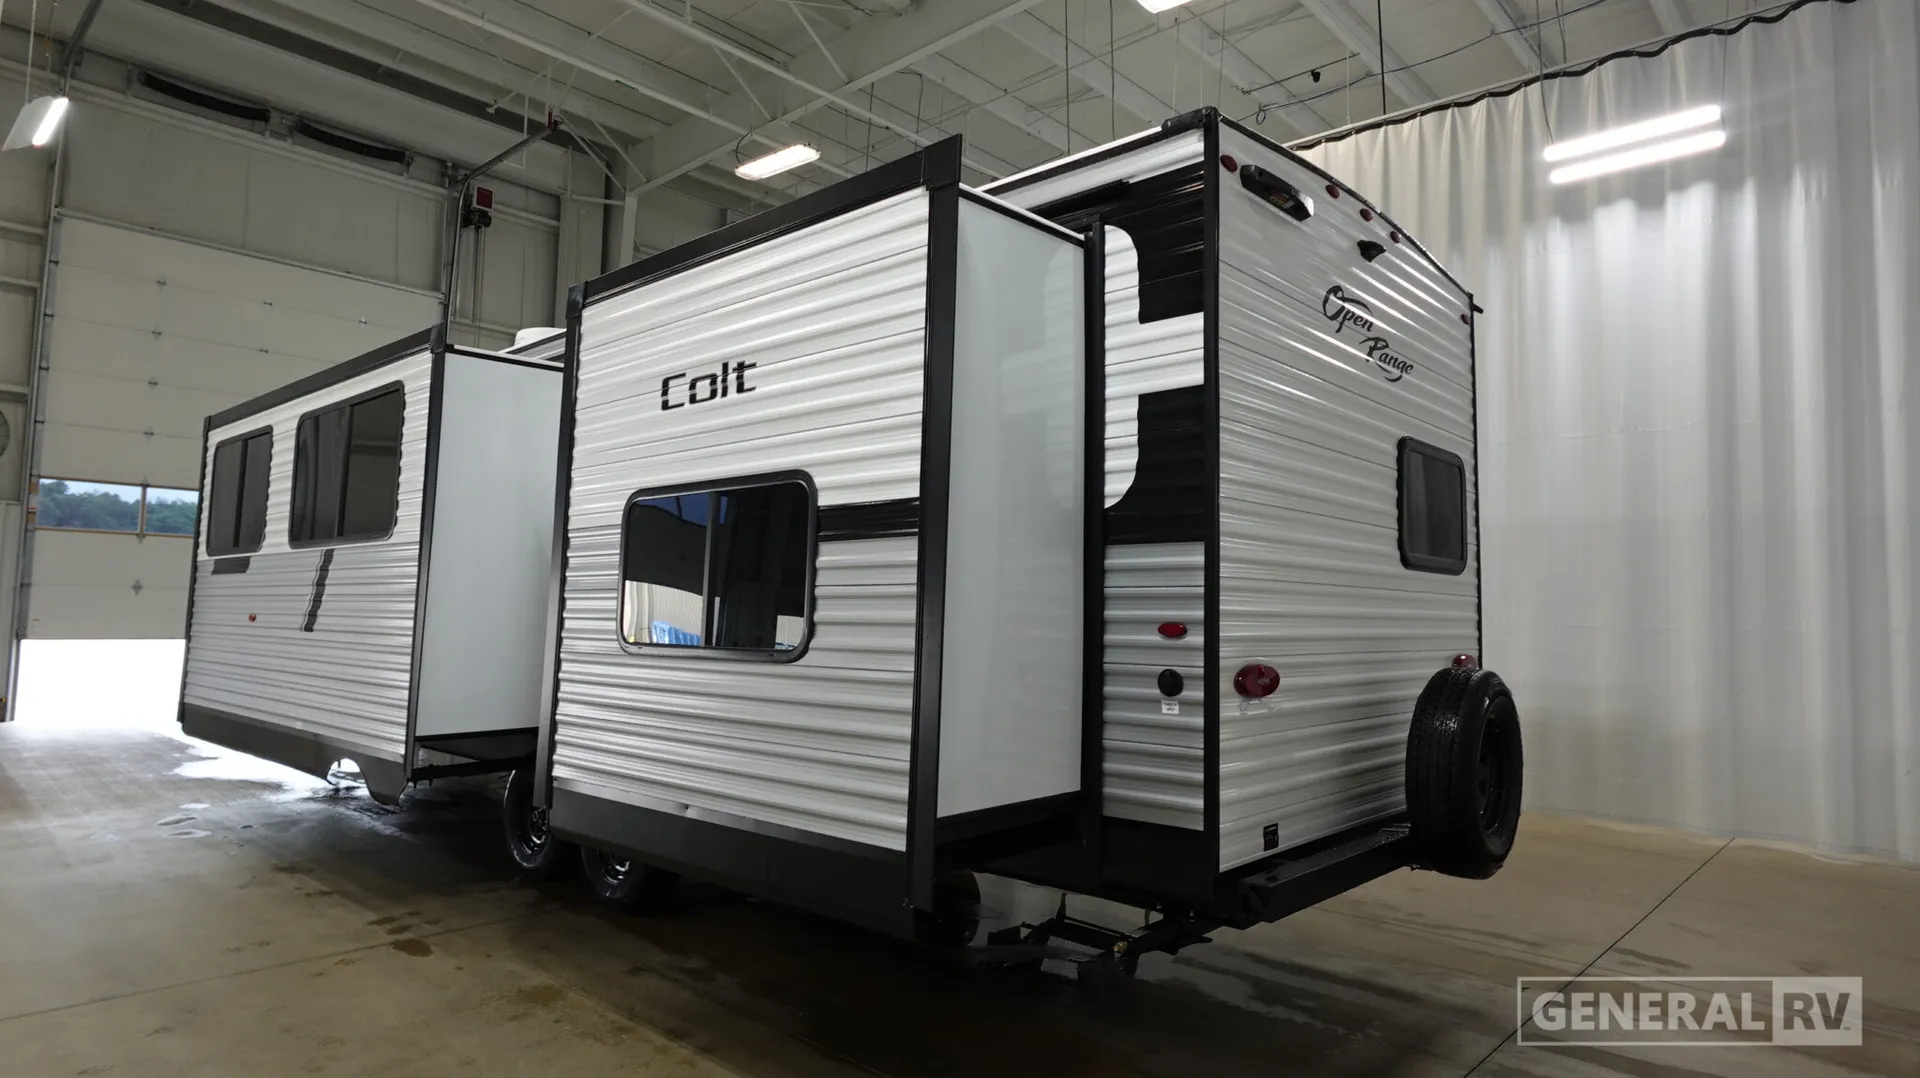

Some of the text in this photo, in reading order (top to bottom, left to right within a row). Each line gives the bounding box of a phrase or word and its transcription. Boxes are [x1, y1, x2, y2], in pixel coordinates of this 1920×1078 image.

[1322, 285, 1374, 333] Open
[1359, 336, 1414, 382] Range
[661, 360, 757, 411] Colt
